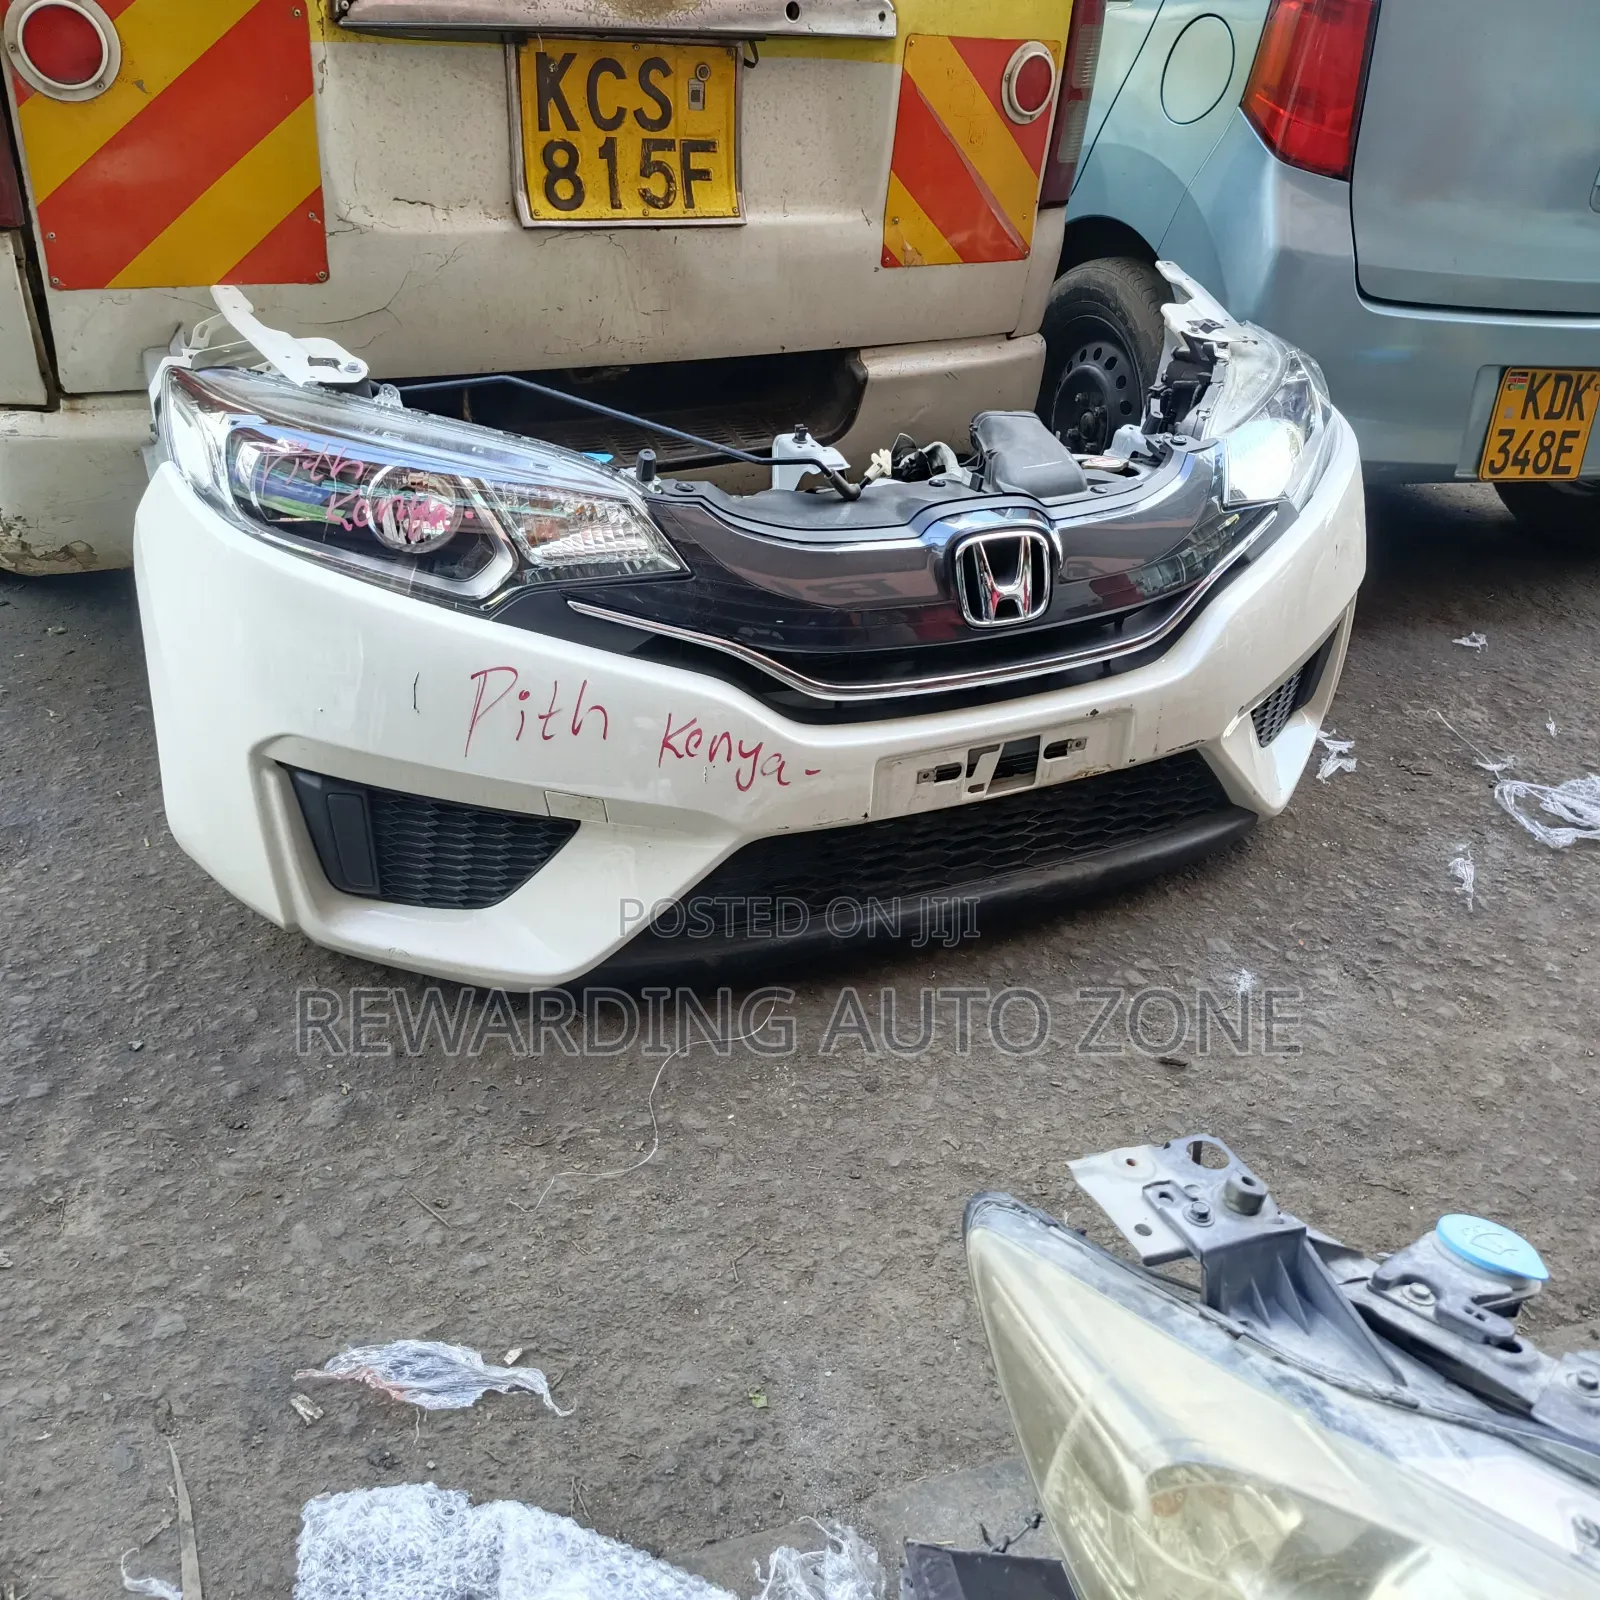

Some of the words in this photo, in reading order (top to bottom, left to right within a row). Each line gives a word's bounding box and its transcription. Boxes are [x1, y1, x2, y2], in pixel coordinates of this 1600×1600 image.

[535, 51, 674, 132] KCS
[541, 136, 719, 211] 815F
[1520, 372, 1597, 421] KDK
[1488, 429, 1581, 475] 348E
[464, 666, 609, 758] Pith
